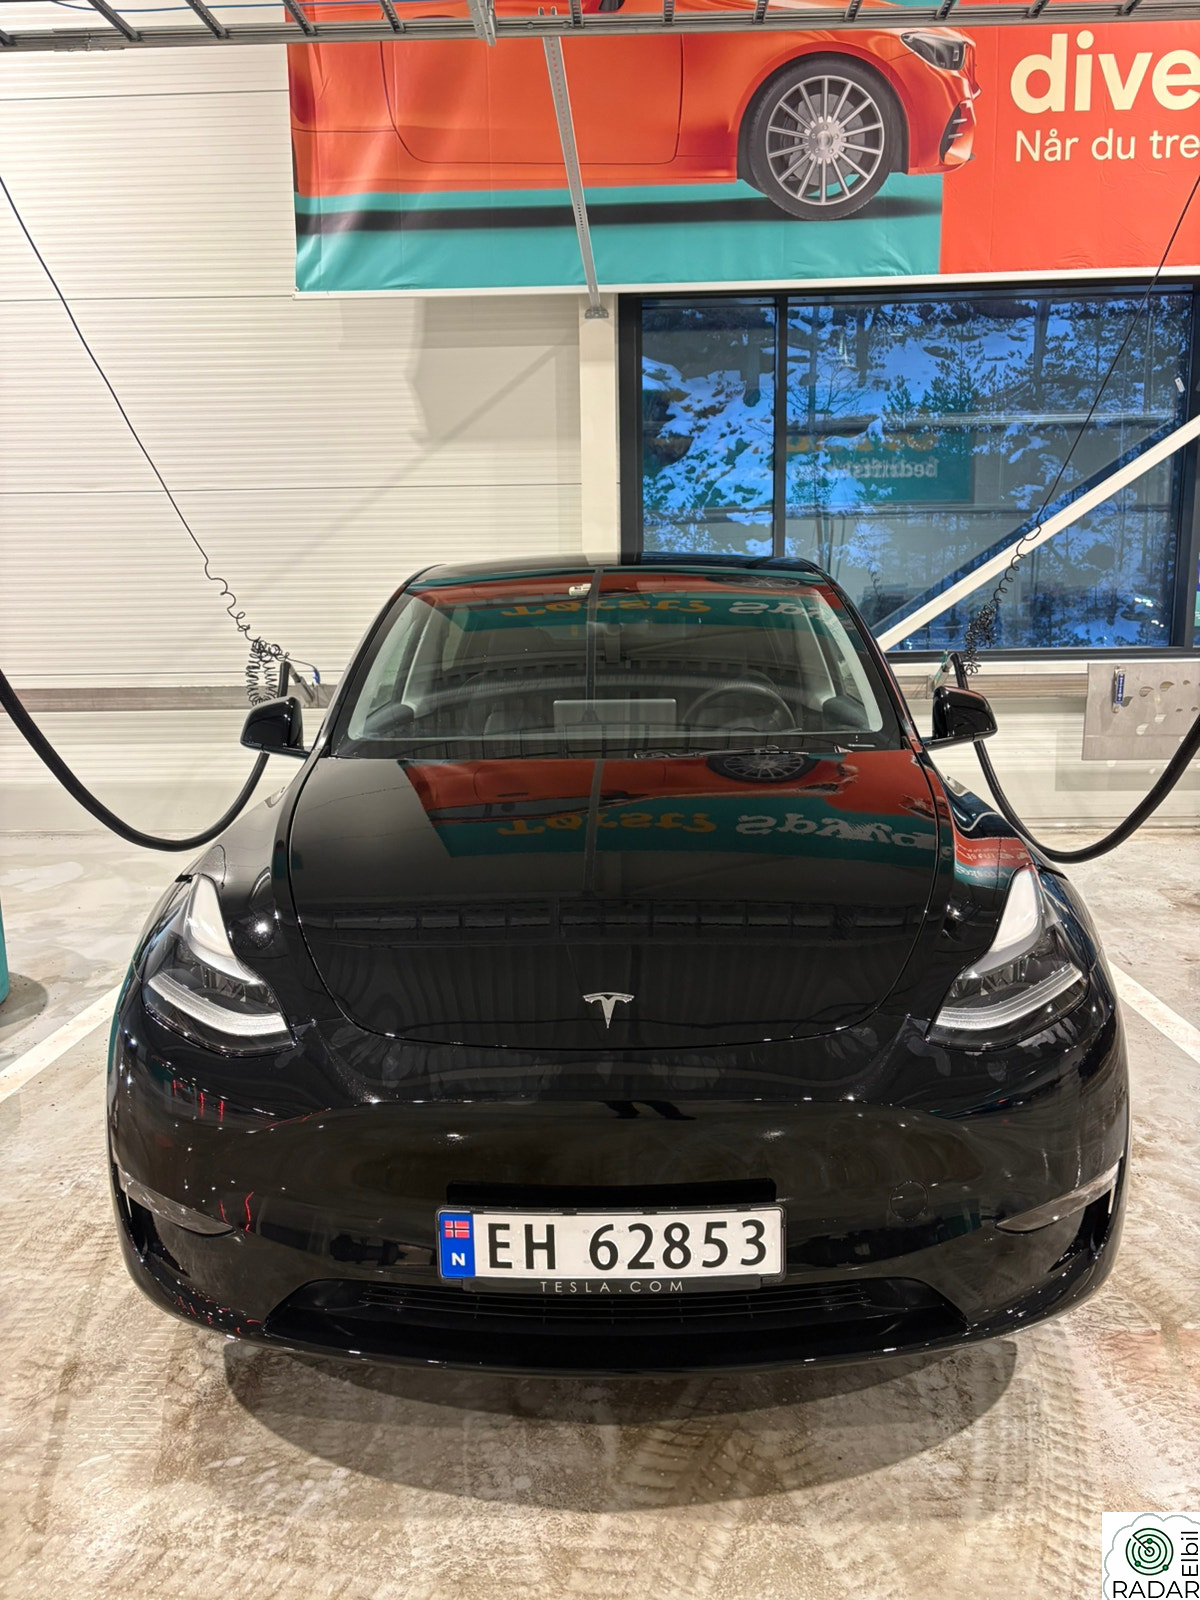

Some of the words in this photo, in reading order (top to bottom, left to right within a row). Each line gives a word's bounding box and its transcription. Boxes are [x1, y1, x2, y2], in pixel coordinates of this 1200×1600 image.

[1010, 30, 1200, 114] dive
[1015, 128, 1079, 162] Når
[1091, 128, 1136, 160] du
[1149, 130, 1200, 159] tre
[451, 1252, 466, 1267] N
[487, 1222, 557, 1270] EH
[588, 1218, 768, 1271] 62853
[539, 1280, 684, 1293] TESLA.COM
